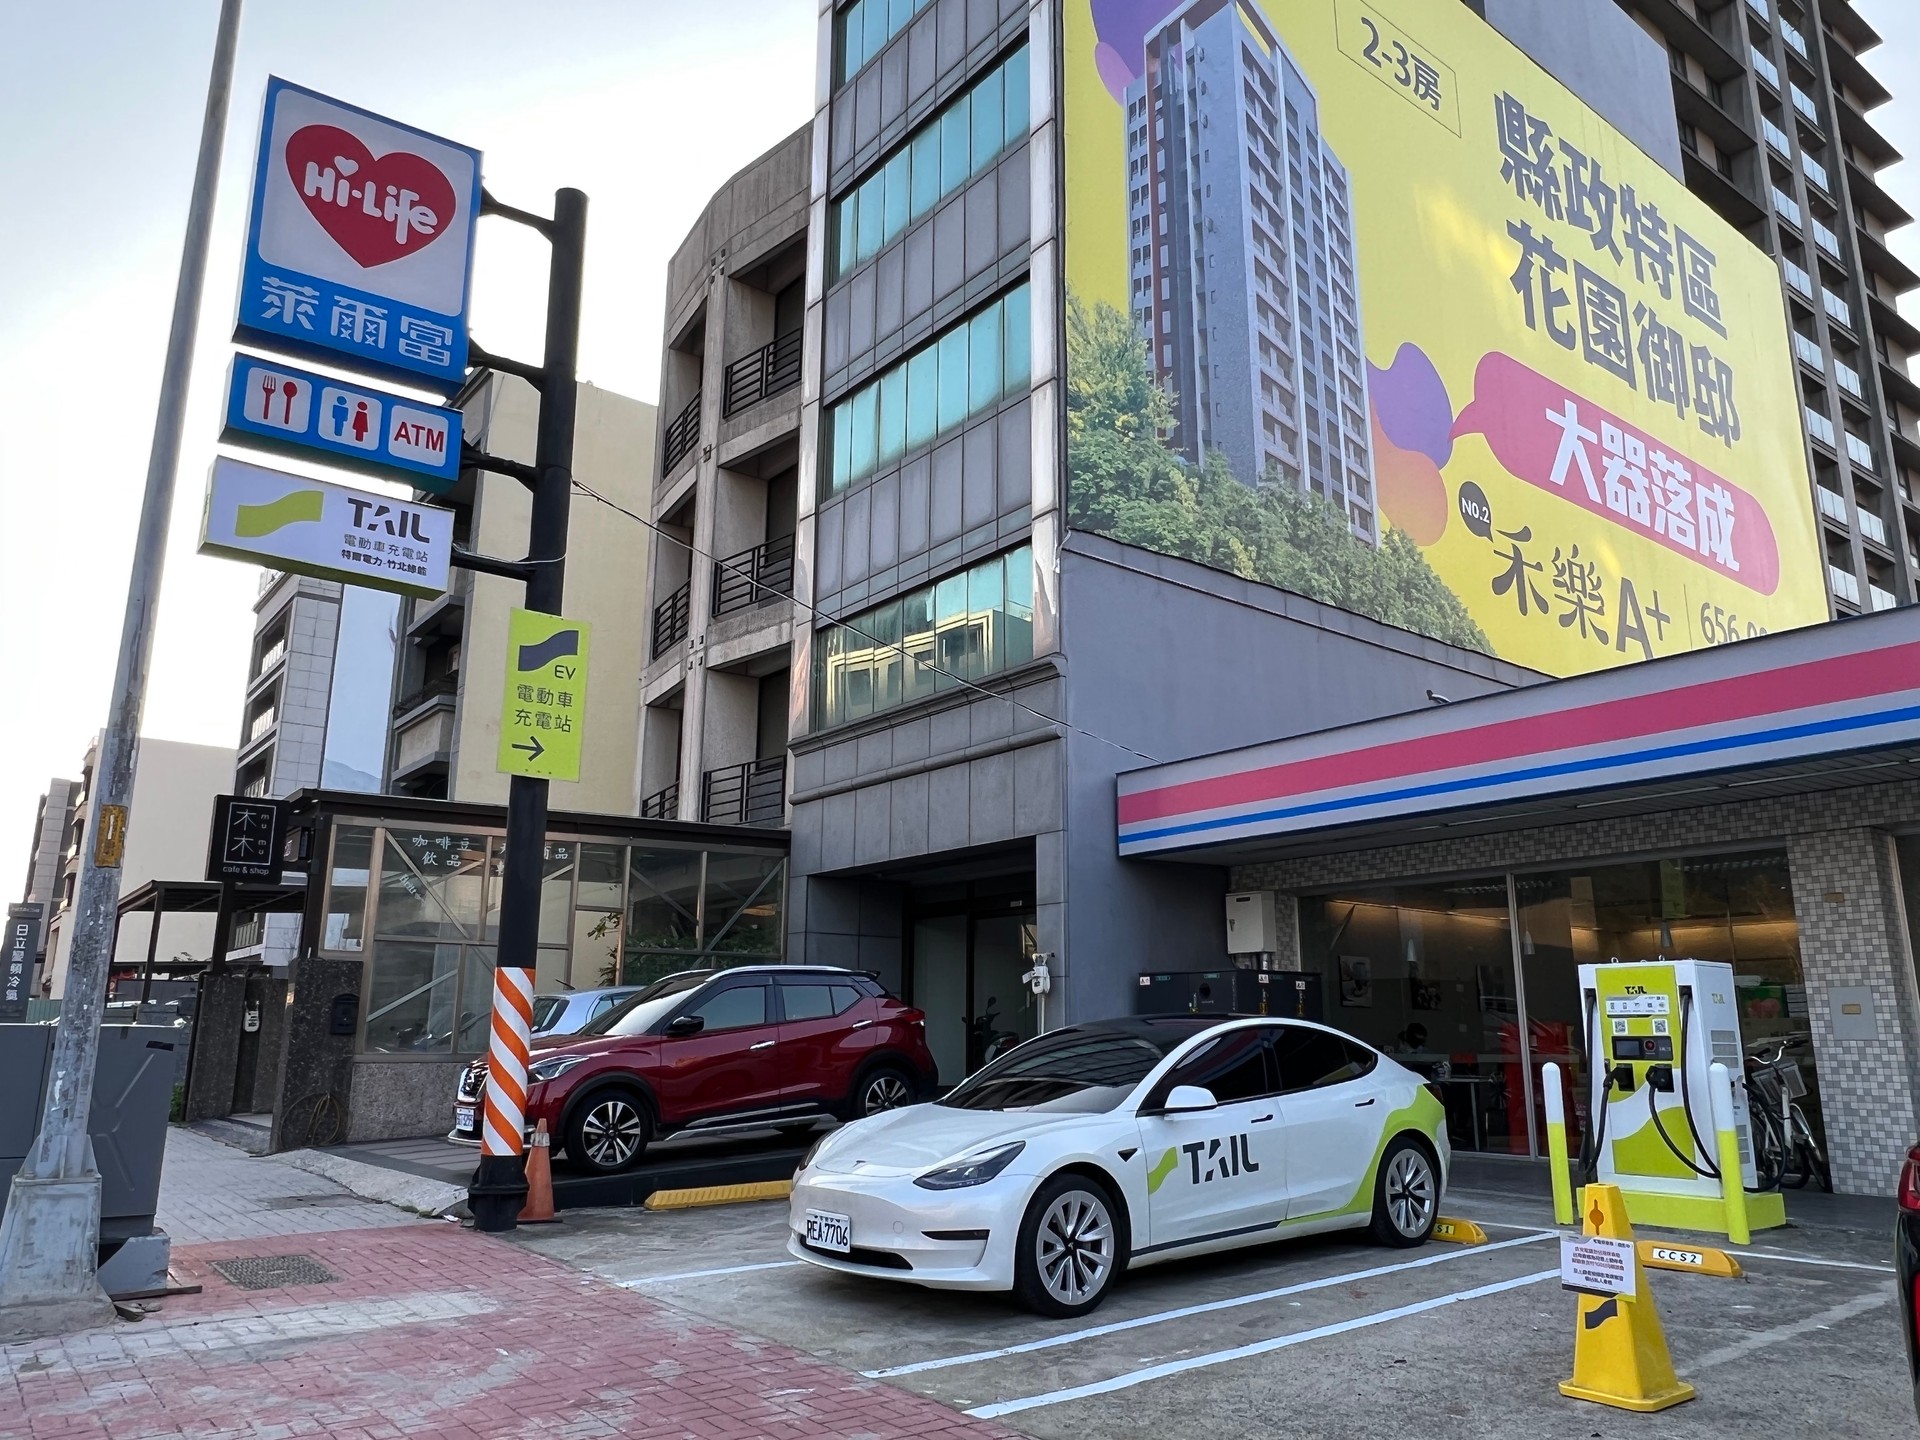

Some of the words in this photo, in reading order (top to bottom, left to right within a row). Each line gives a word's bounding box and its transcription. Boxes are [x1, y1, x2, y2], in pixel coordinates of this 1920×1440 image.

[1360, 16, 1442, 112] 2-3房
[304, 156, 438, 244] Hi-Life
[1494, 90, 1728, 340] 縣政特區
[261, 276, 452, 367] 萊爾富
[1506, 219, 1742, 448] 花園御邸
[394, 421, 445, 453] ATM
[1545, 398, 1741, 572] 大器落成
[347, 497, 430, 544] TAIL
[1461, 496, 1491, 525] NO.2
[343, 533, 429, 563] 電動車充電站
[554, 664, 577, 680] EV
[517, 684, 574, 708] 電動車
[514, 708, 572, 733] 充電站
[412, 834, 472, 852] 咖啡豆
[241, 866, 249, 874] &
[249, 867, 270, 876] shop
[421, 851, 462, 868] 飲品
[1624, 986, 1647, 995] TAIL
[1182, 1132, 1260, 1186] TAIL
[1658, 1250, 1697, 1264] CCS2
